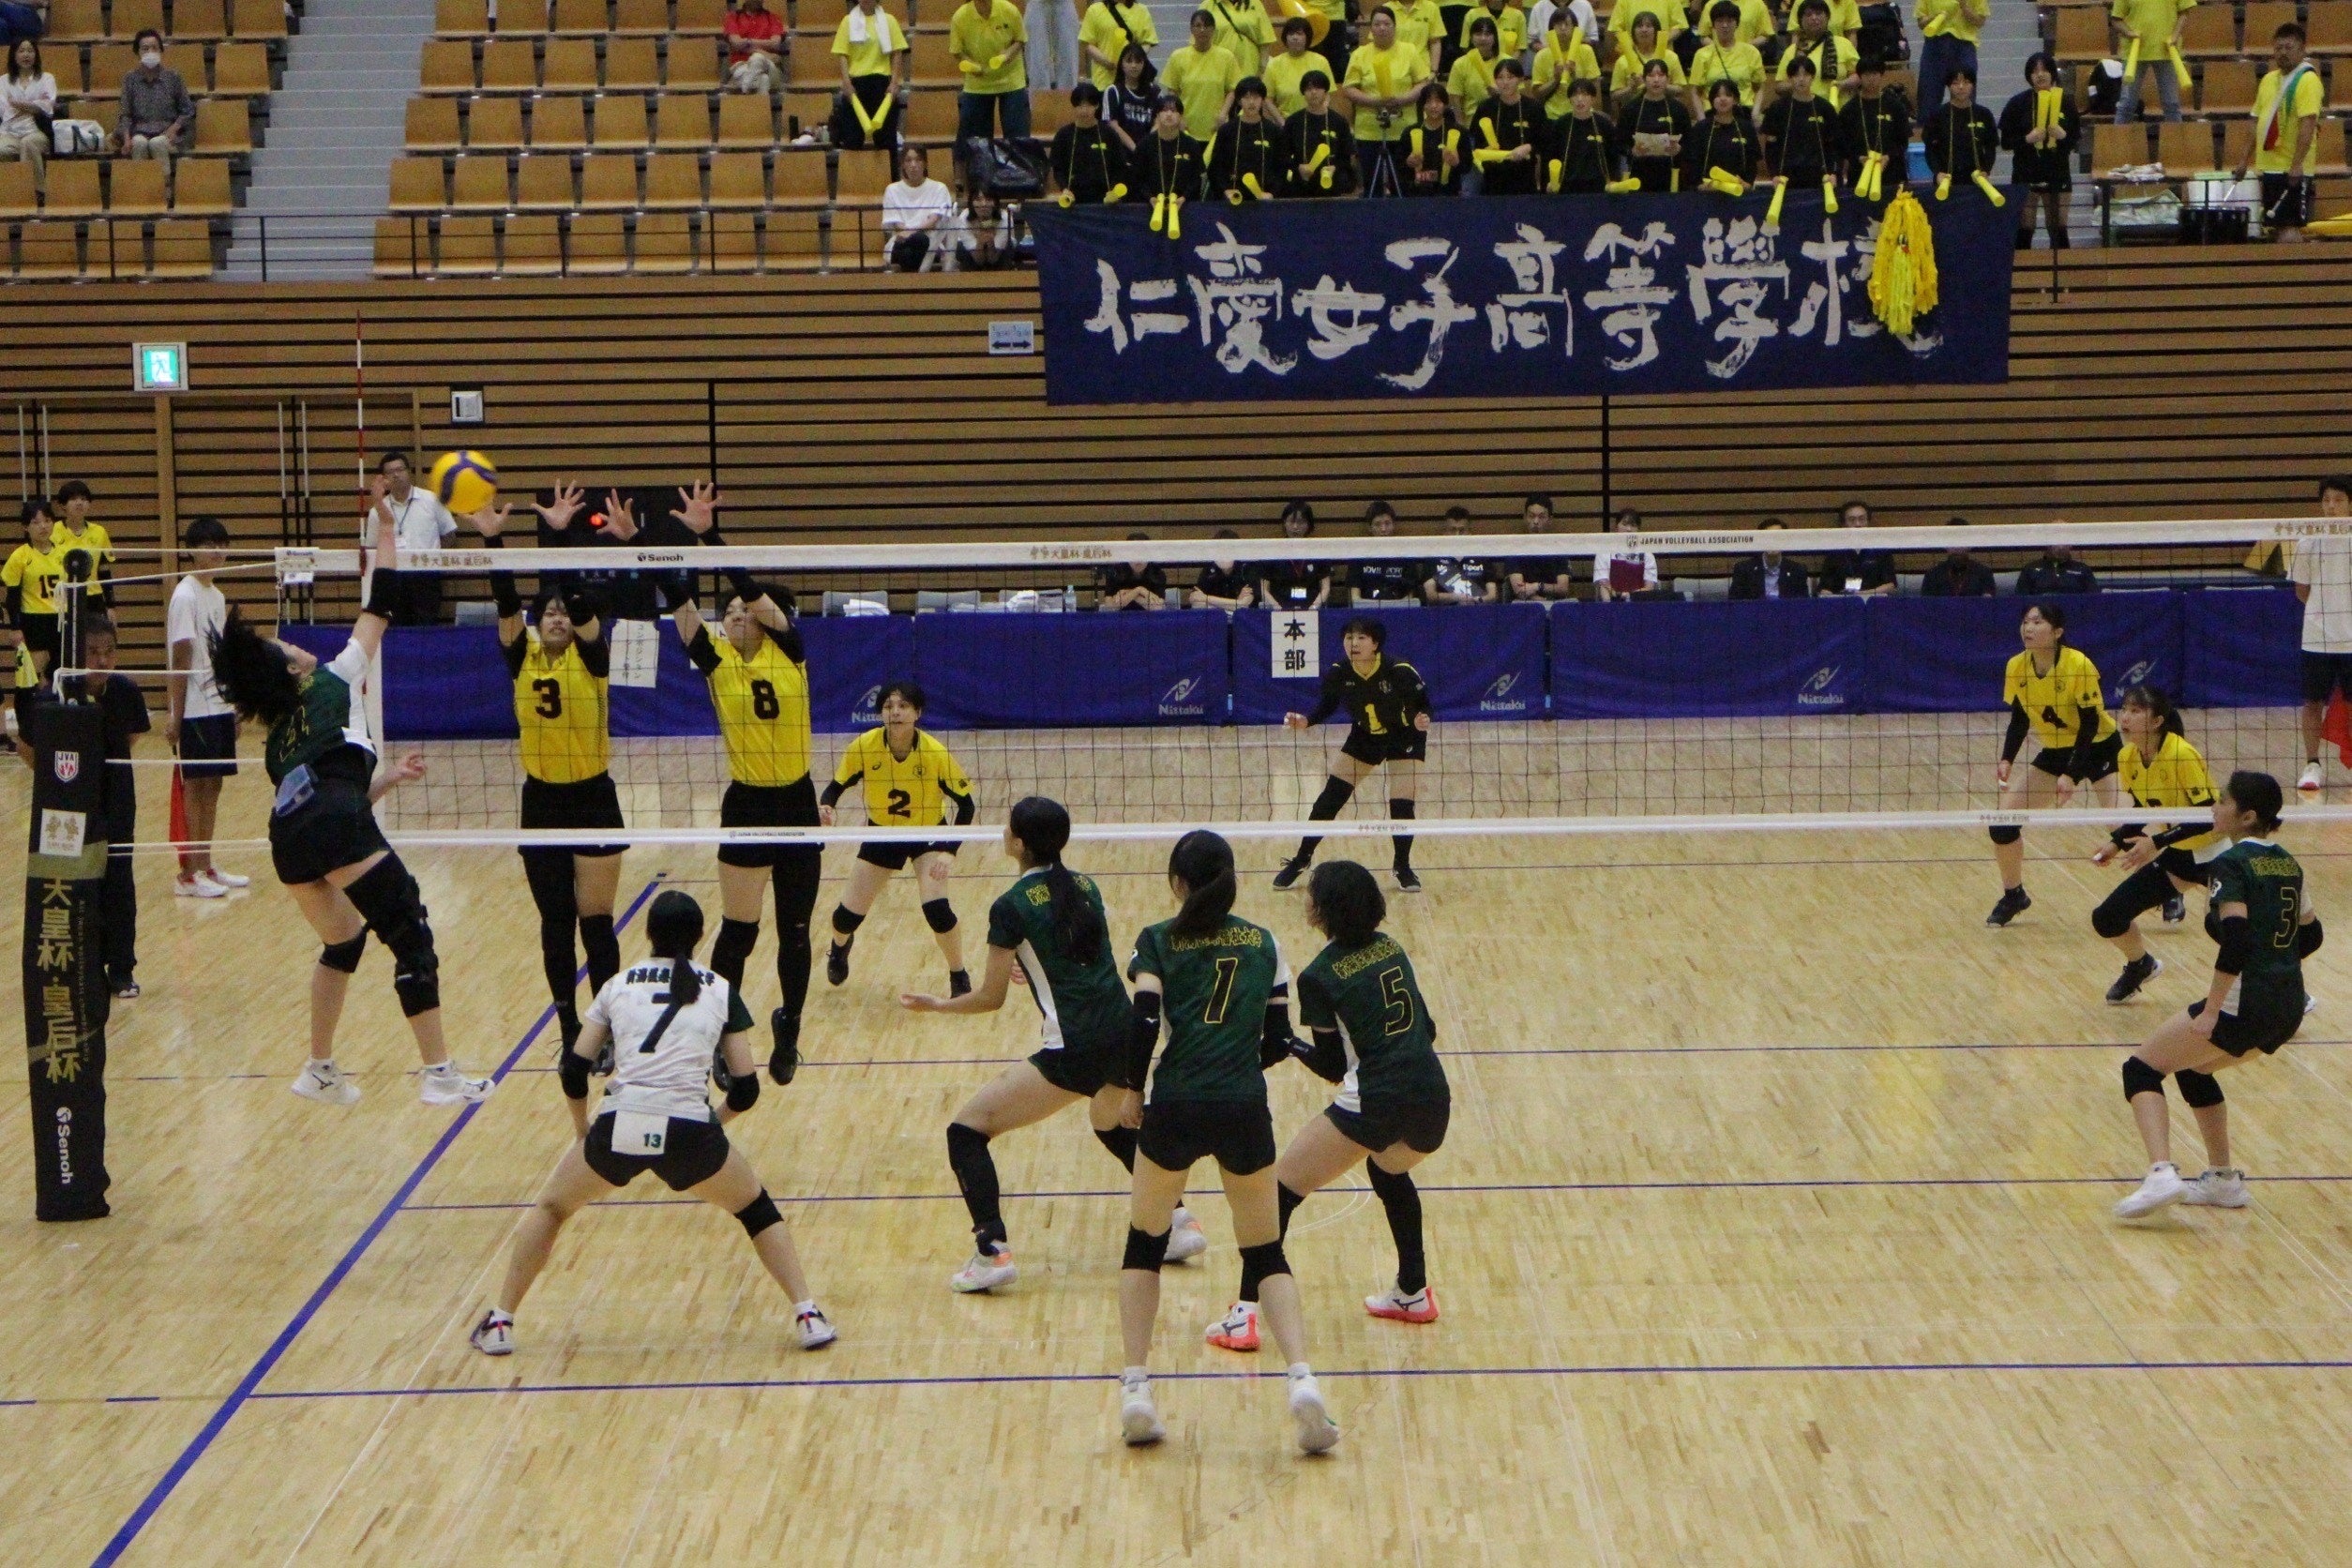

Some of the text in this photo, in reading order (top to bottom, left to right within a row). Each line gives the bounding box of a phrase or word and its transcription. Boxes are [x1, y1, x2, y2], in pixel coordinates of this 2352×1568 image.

[1284, 619, 1305, 671] 本部
[532, 678, 562, 719] 3
[751, 680, 779, 719] 8
[1158, 703, 1204, 716] Nittaku
[1364, 703, 1388, 734] 1
[2041, 705, 2068, 729] 4
[58, 753, 75, 761] JVA
[887, 789, 911, 819] 2
[2273, 886, 2299, 948] 3
[1204, 957, 1239, 1024] 1
[1380, 965, 1414, 1036] 5
[638, 991, 694, 1053] 7
[57, 1124, 74, 1184] Senoh
[643, 1133, 661, 1149] 13
